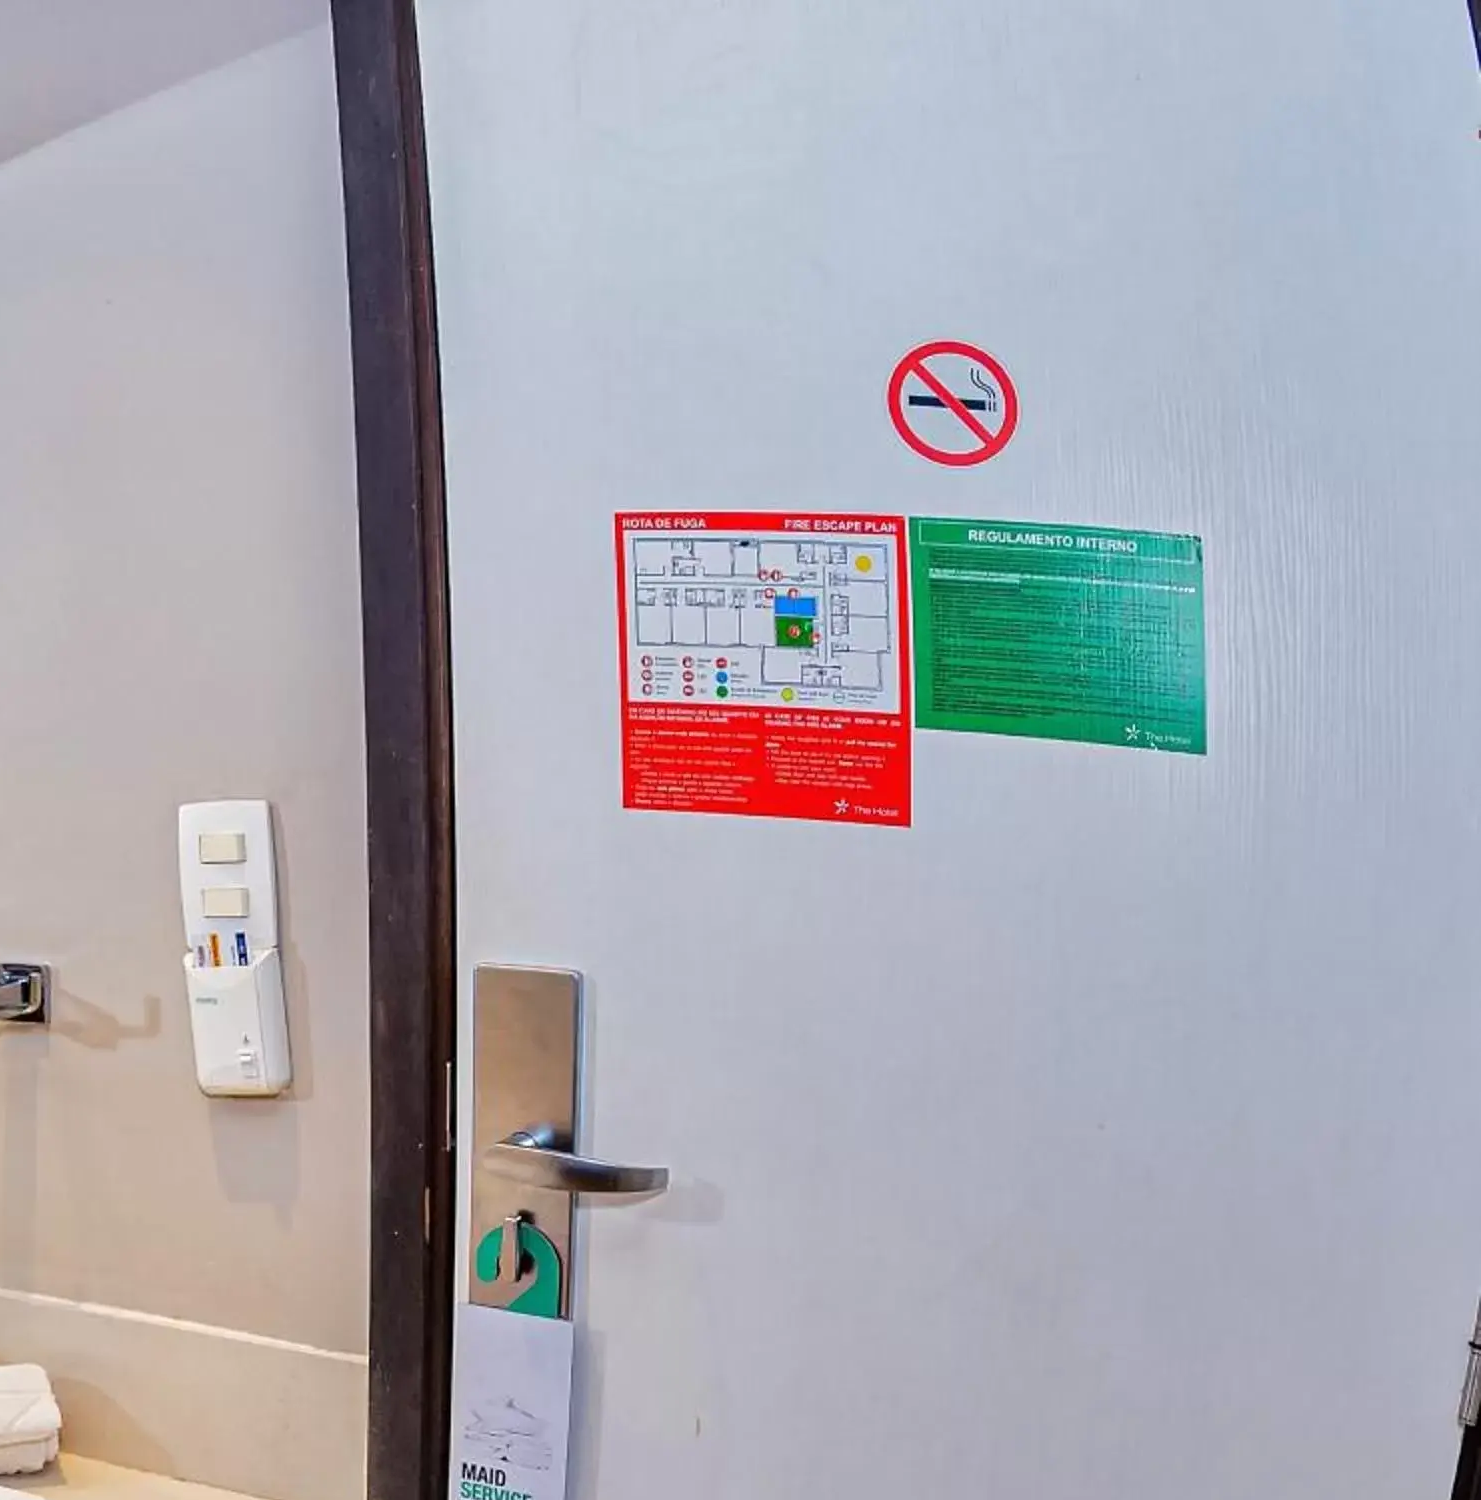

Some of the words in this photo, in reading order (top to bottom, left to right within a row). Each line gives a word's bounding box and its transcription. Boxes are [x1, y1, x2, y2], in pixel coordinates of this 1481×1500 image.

[622, 518, 654, 529] ROTA
[655, 518, 671, 529] DE
[674, 518, 706, 529] FUGA
[784, 519, 811, 530] FIRE
[814, 519, 861, 531] ESCAPE
[864, 521, 897, 533] PLAN
[968, 529, 1073, 549] REGULAMENTO
[1076, 538, 1137, 553] INTERNO
[461, 1462, 506, 1487] MAID
